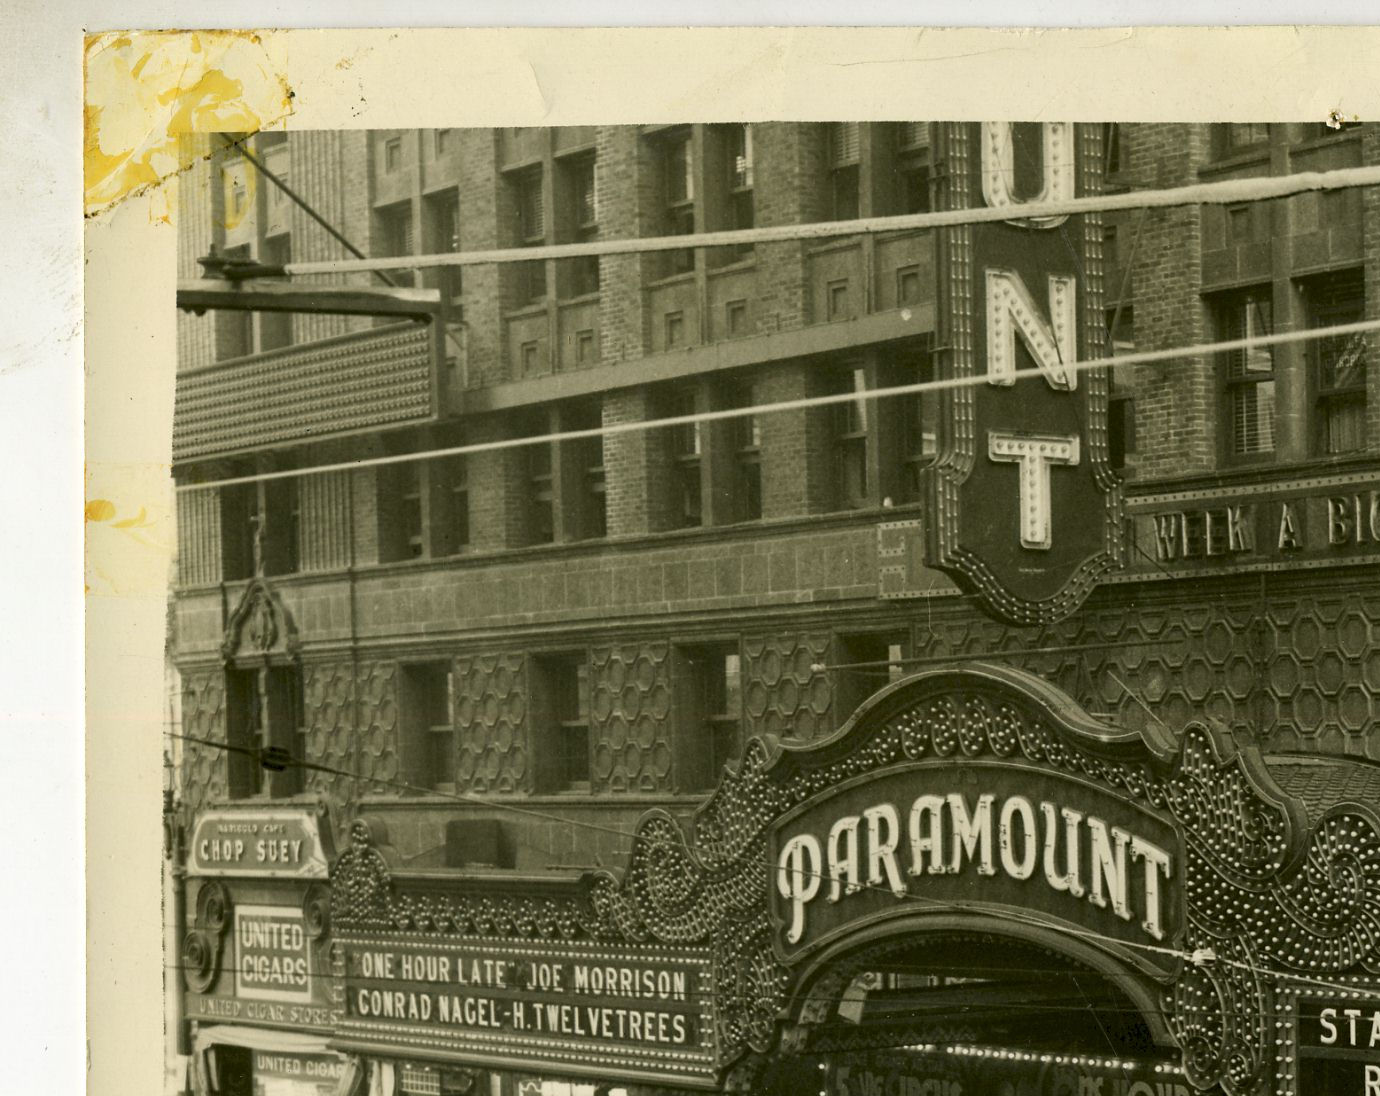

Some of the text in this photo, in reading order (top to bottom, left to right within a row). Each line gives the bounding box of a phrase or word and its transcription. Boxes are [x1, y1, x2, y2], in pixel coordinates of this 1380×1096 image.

[1153, 504, 1252, 560] WEEK
[1278, 503, 1303, 550] A
[201, 839, 302, 862] CHOP SUEY
[777, 793, 1171, 944] PARAMOUNT
[241, 921, 303, 951] UNITED
[242, 955, 307, 985] CIGARS
[402, 955, 450, 982] HOUR
[527, 963, 564, 992] JOE
[575, 966, 685, 1000] MORRISON
[200, 999, 338, 1025] UNITED CIGAR STORES
[358, 990, 431, 1021] CONRAD
[257, 1055, 300, 1074] UNITED
